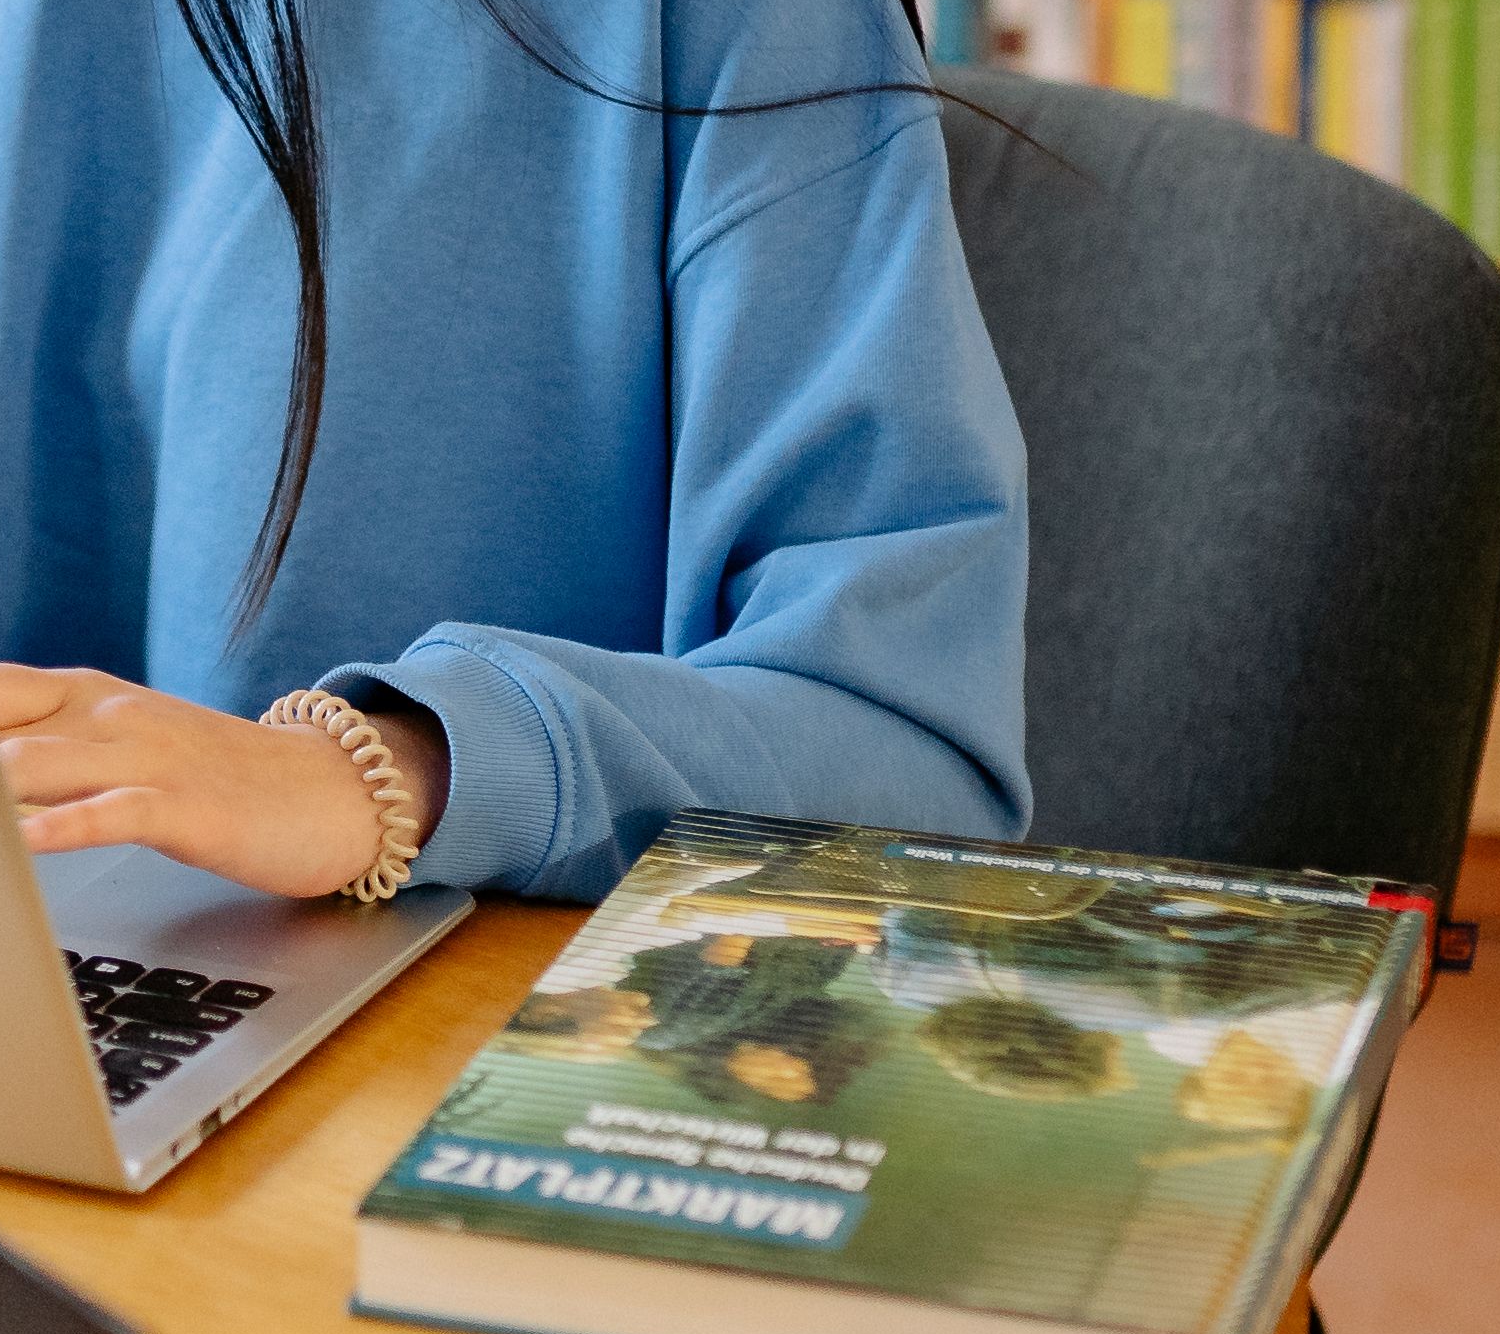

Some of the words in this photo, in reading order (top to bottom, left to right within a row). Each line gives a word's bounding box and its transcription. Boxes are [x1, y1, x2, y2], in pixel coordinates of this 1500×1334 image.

[904, 847, 954, 862] Welle
[959, 853, 1055, 873] Deutschen
[1059, 864, 1091, 875] der
[417, 1145, 845, 1241] MARKTPLATZ
